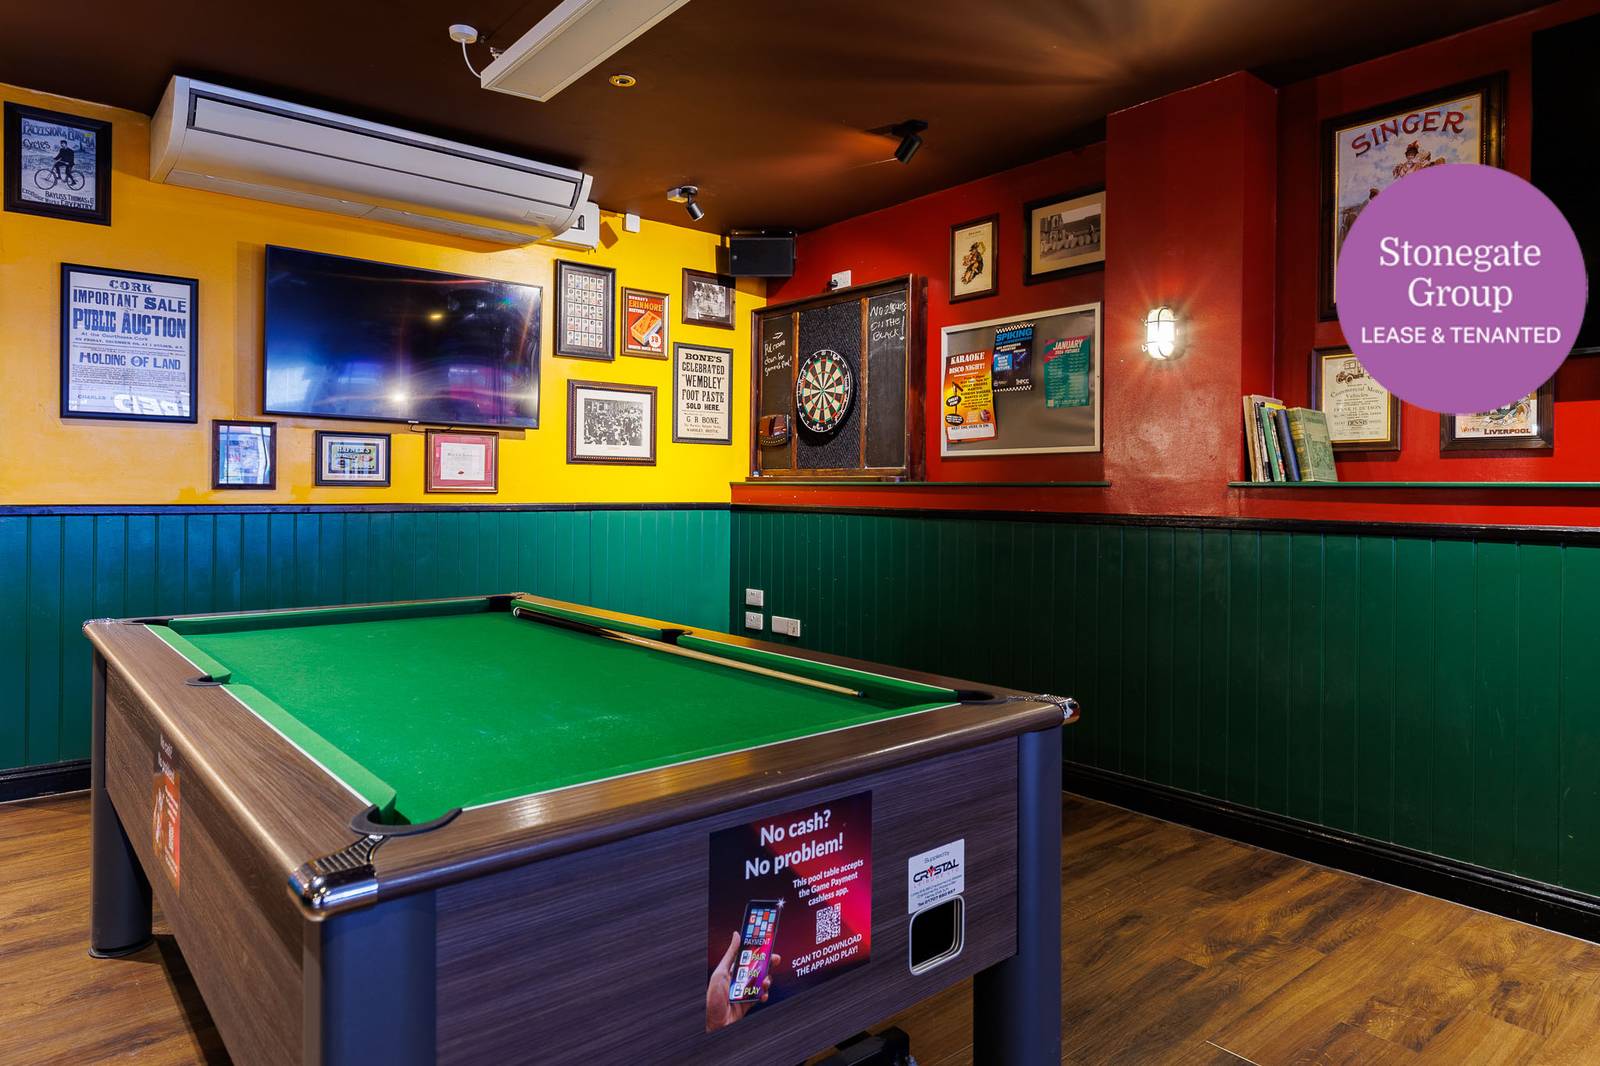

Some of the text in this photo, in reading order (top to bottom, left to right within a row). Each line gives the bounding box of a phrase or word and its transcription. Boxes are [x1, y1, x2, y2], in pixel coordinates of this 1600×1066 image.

[1351, 111, 1465, 157] SINGER
[109, 279, 153, 293] CORK
[73, 289, 187, 314] IMPORTANT SALE
[72, 308, 187, 339] PUBLIC AUCTION
[996, 328, 1032, 342] SPIKING
[1053, 339, 1084, 351] JANUARY
[80, 352, 181, 370] HOLDING OF LAND
[685, 353, 722, 363] BONE'S
[950, 351, 985, 365] KARAOKE
[682, 361, 725, 375] CELEBRATED
[949, 366, 965, 374] DISCO
[682, 389, 725, 403] FOOT PASTE
[686, 402, 701, 410] SOLD
[760, 809, 831, 846] No cash?
[745, 832, 844, 880] No problem!
[793, 859, 864, 889] This pool table accepts
[913, 858, 960, 883] CRYSTAL
[799, 872, 858, 898] the Game Payment
[808, 886, 849, 906] cashless app.
[744, 938, 770, 946] PAYMENT
[752, 953, 766, 961] PAIR
[792, 933, 862, 968] SCAN TO DOWNLOAD
[796, 945, 859, 978] THE APP AND PLAY!
[744, 987, 760, 995] PLAY
